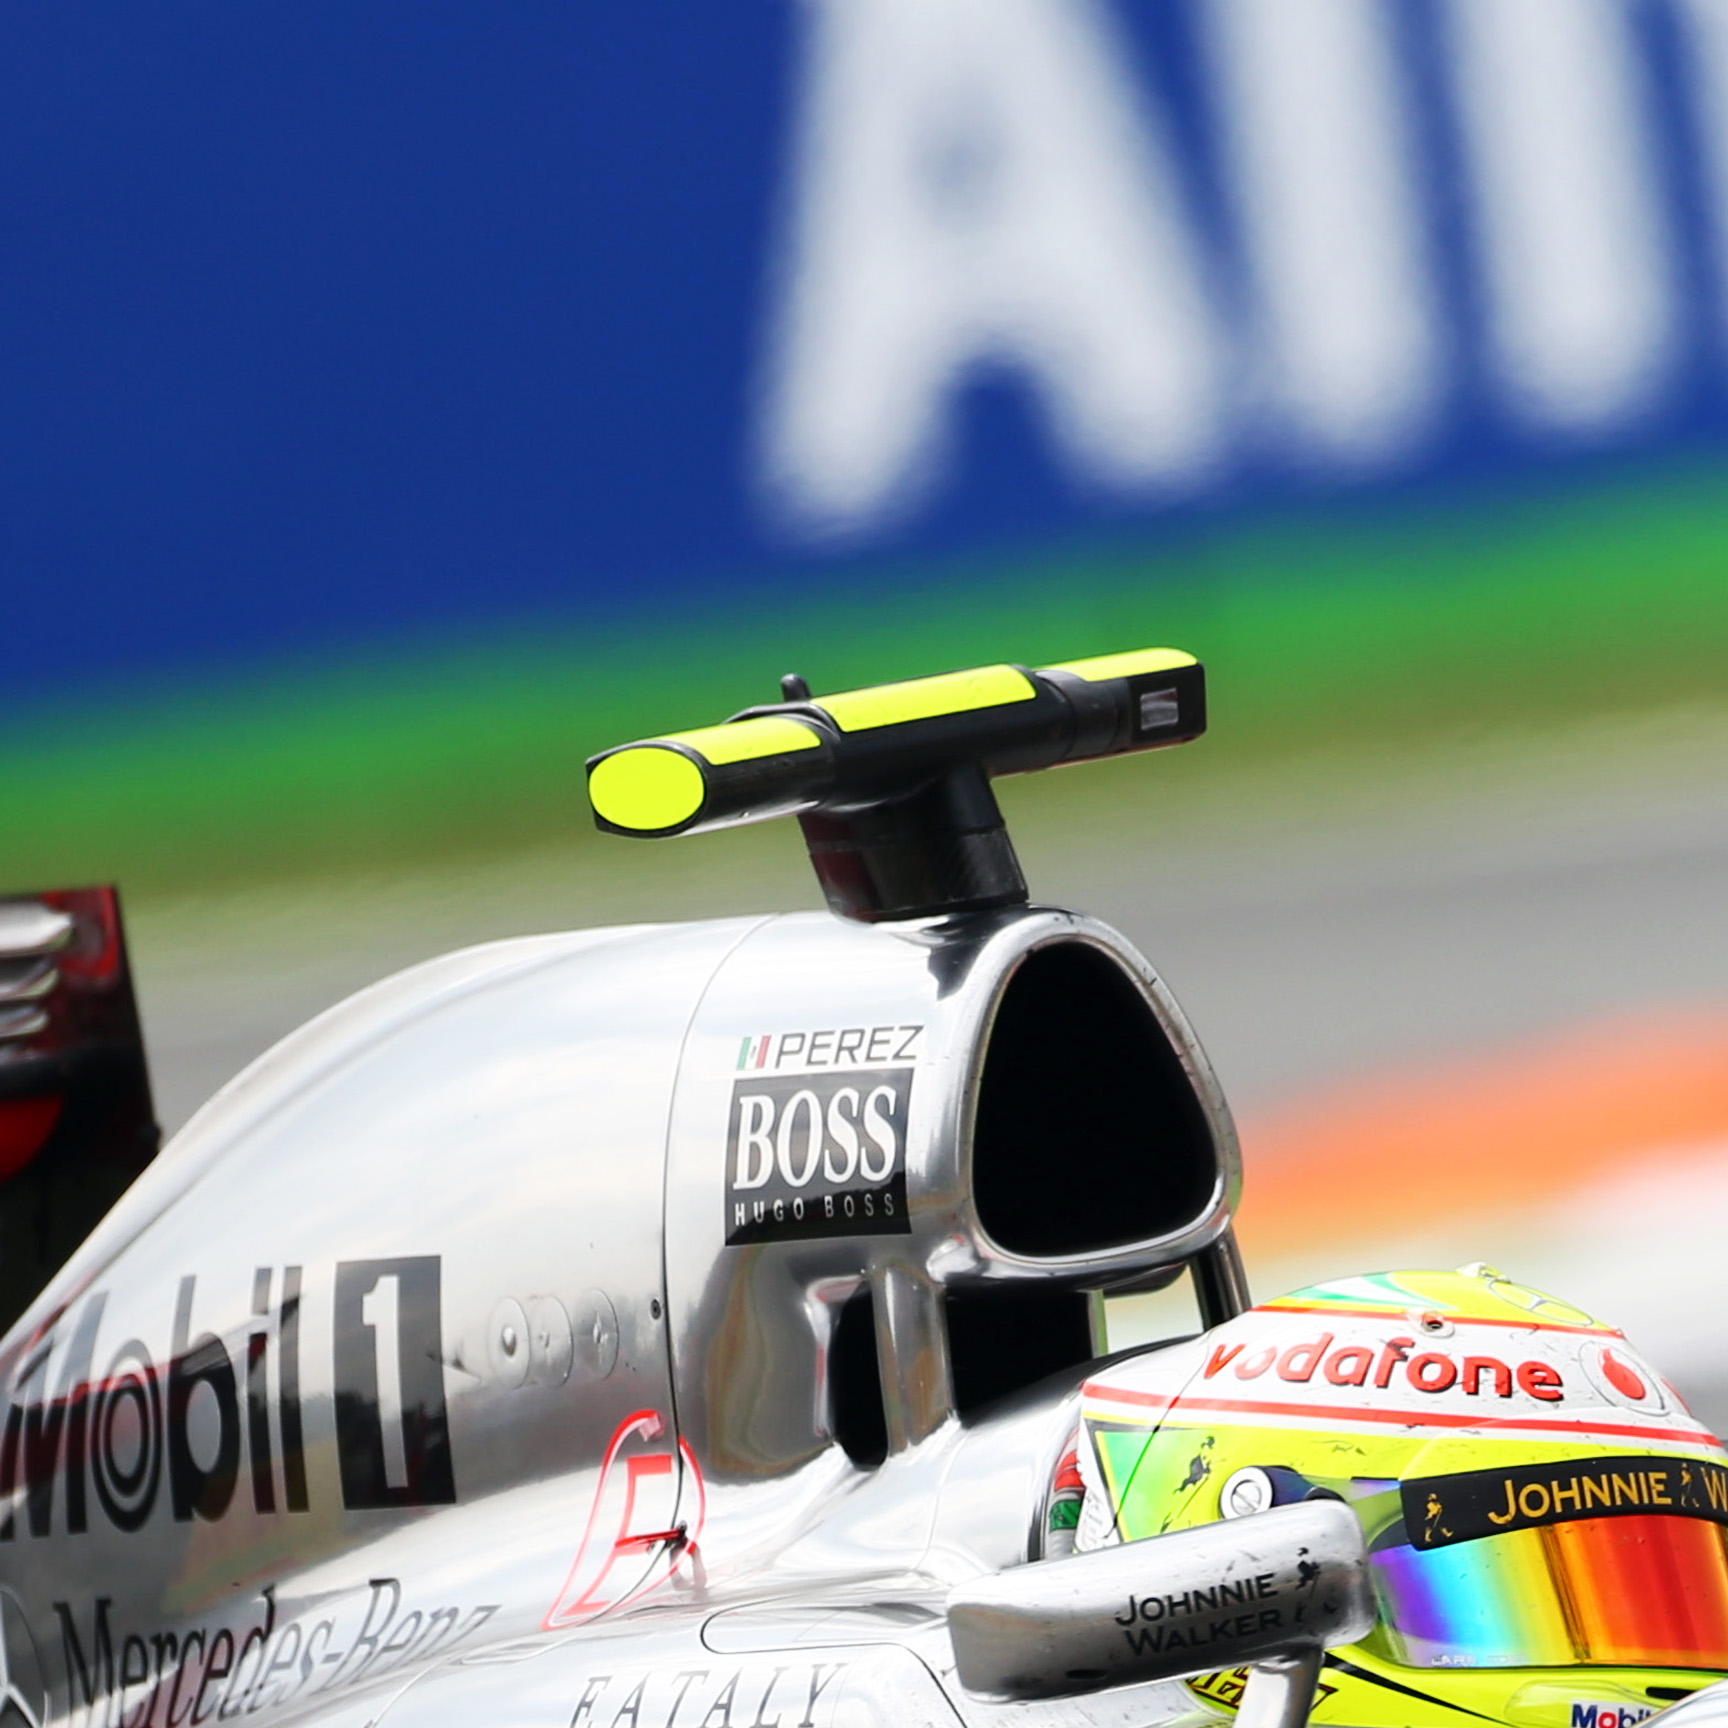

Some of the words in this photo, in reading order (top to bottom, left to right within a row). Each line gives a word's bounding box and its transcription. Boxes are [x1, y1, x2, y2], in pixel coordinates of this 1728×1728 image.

[775, 1025, 924, 1069] PEREZ
[733, 1085, 897, 1190] BOSS
[735, 1197, 805, 1226] HUGO
[824, 1193, 895, 1218] BOSS
[1203, 1331, 1564, 1401] vodafone
[0, 1265, 310, 1542] Mobil
[1486, 1471, 1673, 1525] JOHNNIE
[1115, 1572, 1279, 1626] JOHNNIE
[1124, 1607, 1284, 1656] WALKER
